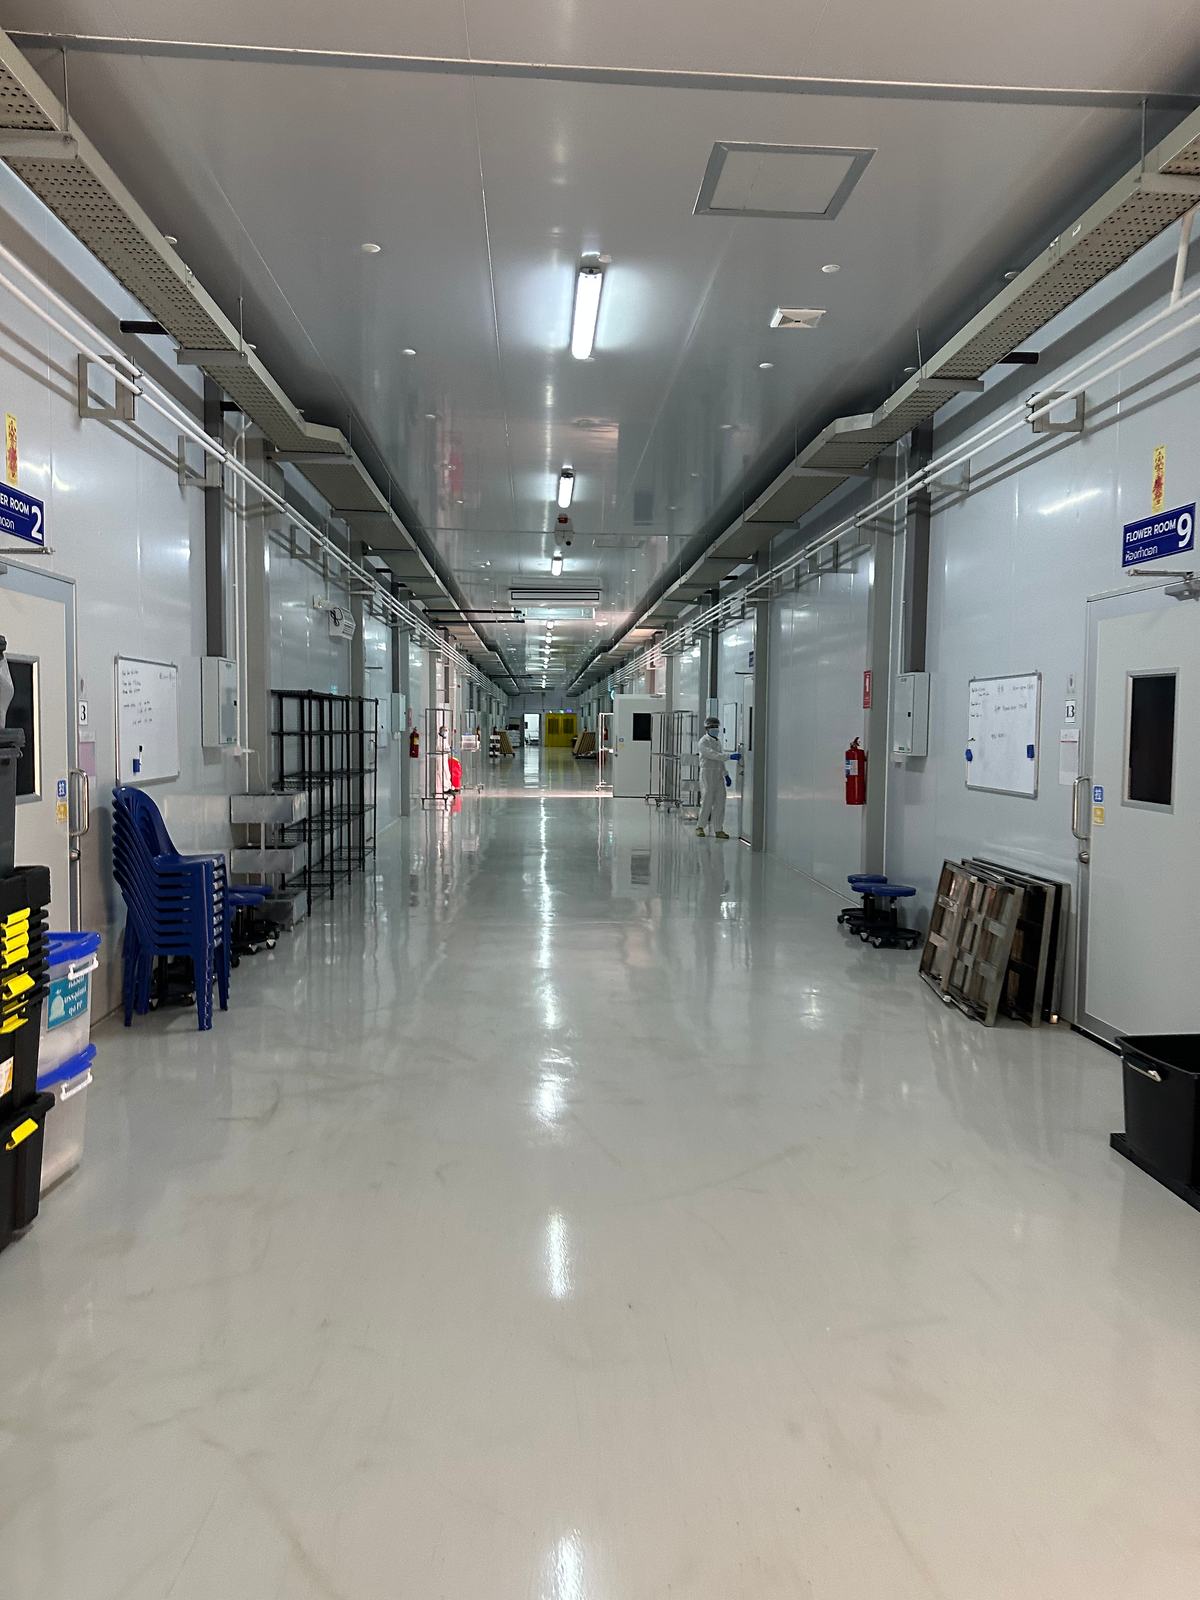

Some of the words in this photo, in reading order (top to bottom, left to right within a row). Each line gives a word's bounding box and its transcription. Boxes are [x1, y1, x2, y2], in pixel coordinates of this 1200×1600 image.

[0, 493, 9, 507] ER
[10, 497, 29, 515] ROOM
[31, 505, 42, 540] 2
[1125, 527, 1152, 543] FLOWER
[1154, 519, 1176, 534] ROOM
[1177, 513, 1192, 547] 9
[81, 705, 86, 720] 3
